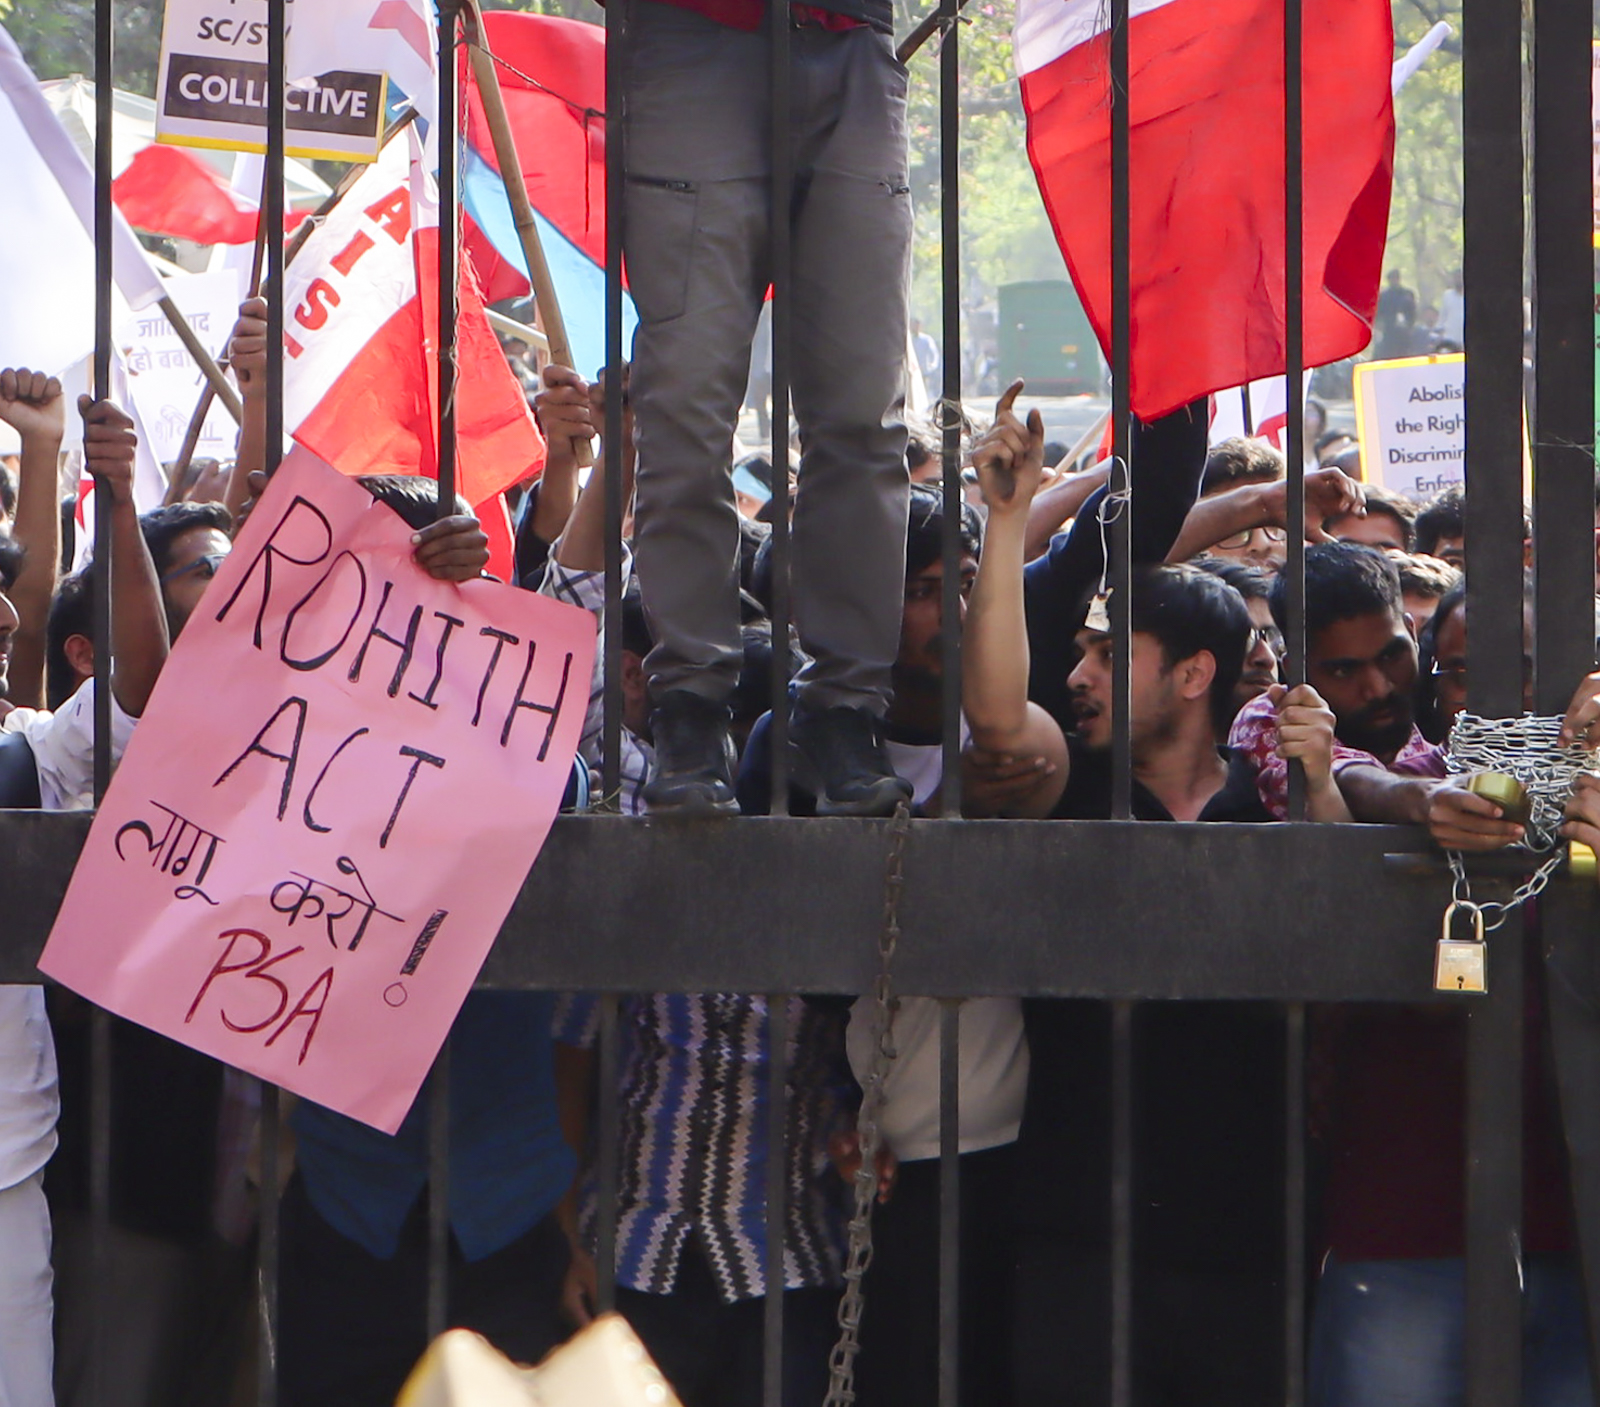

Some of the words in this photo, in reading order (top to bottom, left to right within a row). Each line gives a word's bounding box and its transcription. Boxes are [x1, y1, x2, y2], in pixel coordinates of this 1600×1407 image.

[178, 72, 369, 119] COLLCTIVE
[1395, 417, 1424, 434] the
[216, 494, 573, 763] ROHITH
[212, 696, 446, 849] ACT
[114, 799, 227, 905] लागू
[184, 928, 335, 1066] PSA
